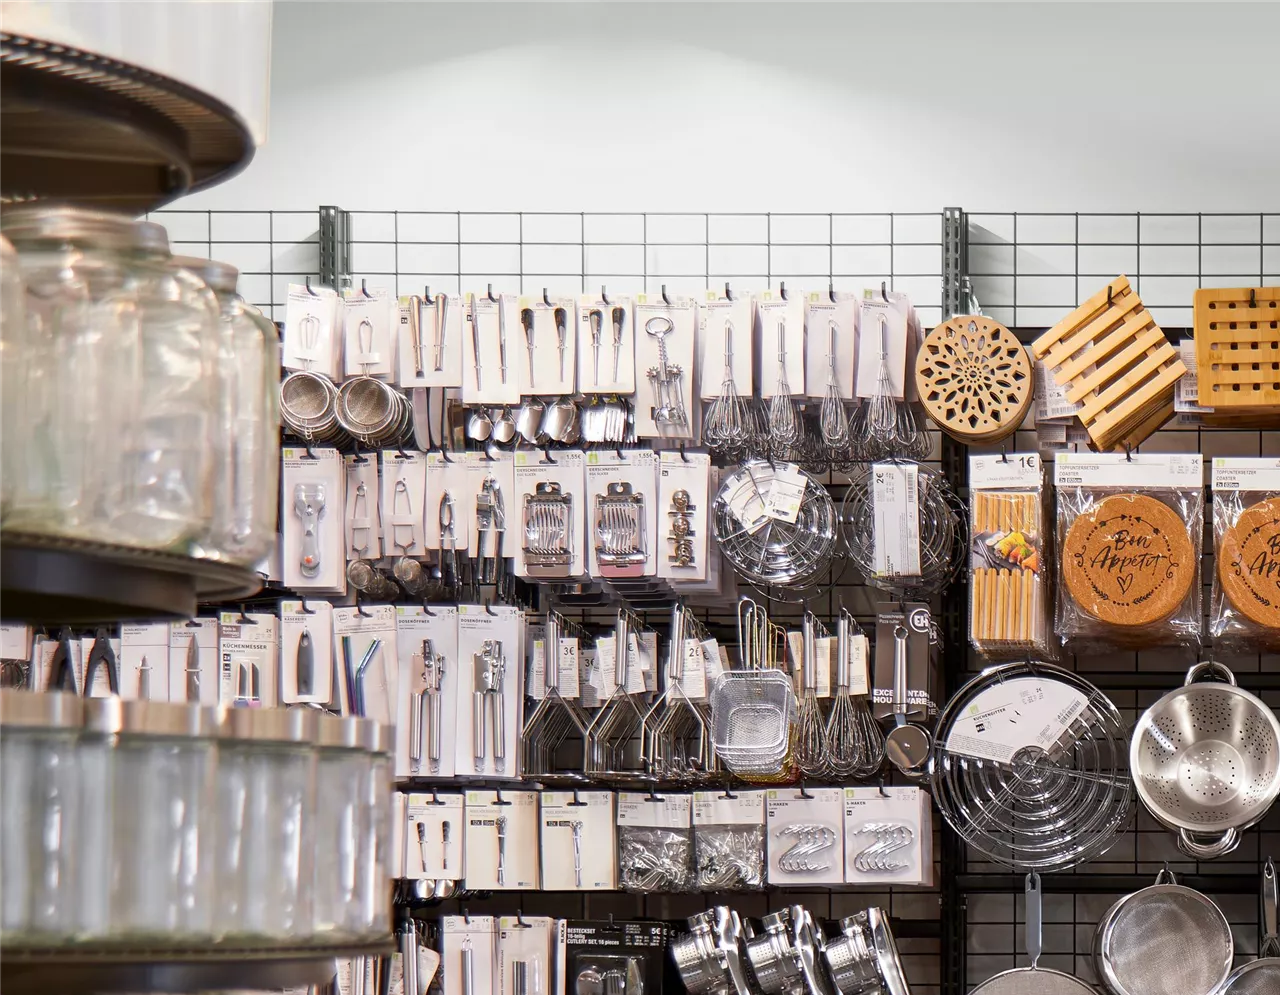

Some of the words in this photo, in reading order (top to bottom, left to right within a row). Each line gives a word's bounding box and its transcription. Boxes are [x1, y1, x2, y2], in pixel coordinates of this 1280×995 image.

[1019, 457, 1035, 468] 1€
[876, 472, 884, 484] 2€
[1113, 529, 1152, 551] Bon
[1090, 545, 1168, 576] Appétit
[563, 646, 575, 656] 3€
[689, 647, 700, 657] 2€
[651, 927, 661, 935] 5€
